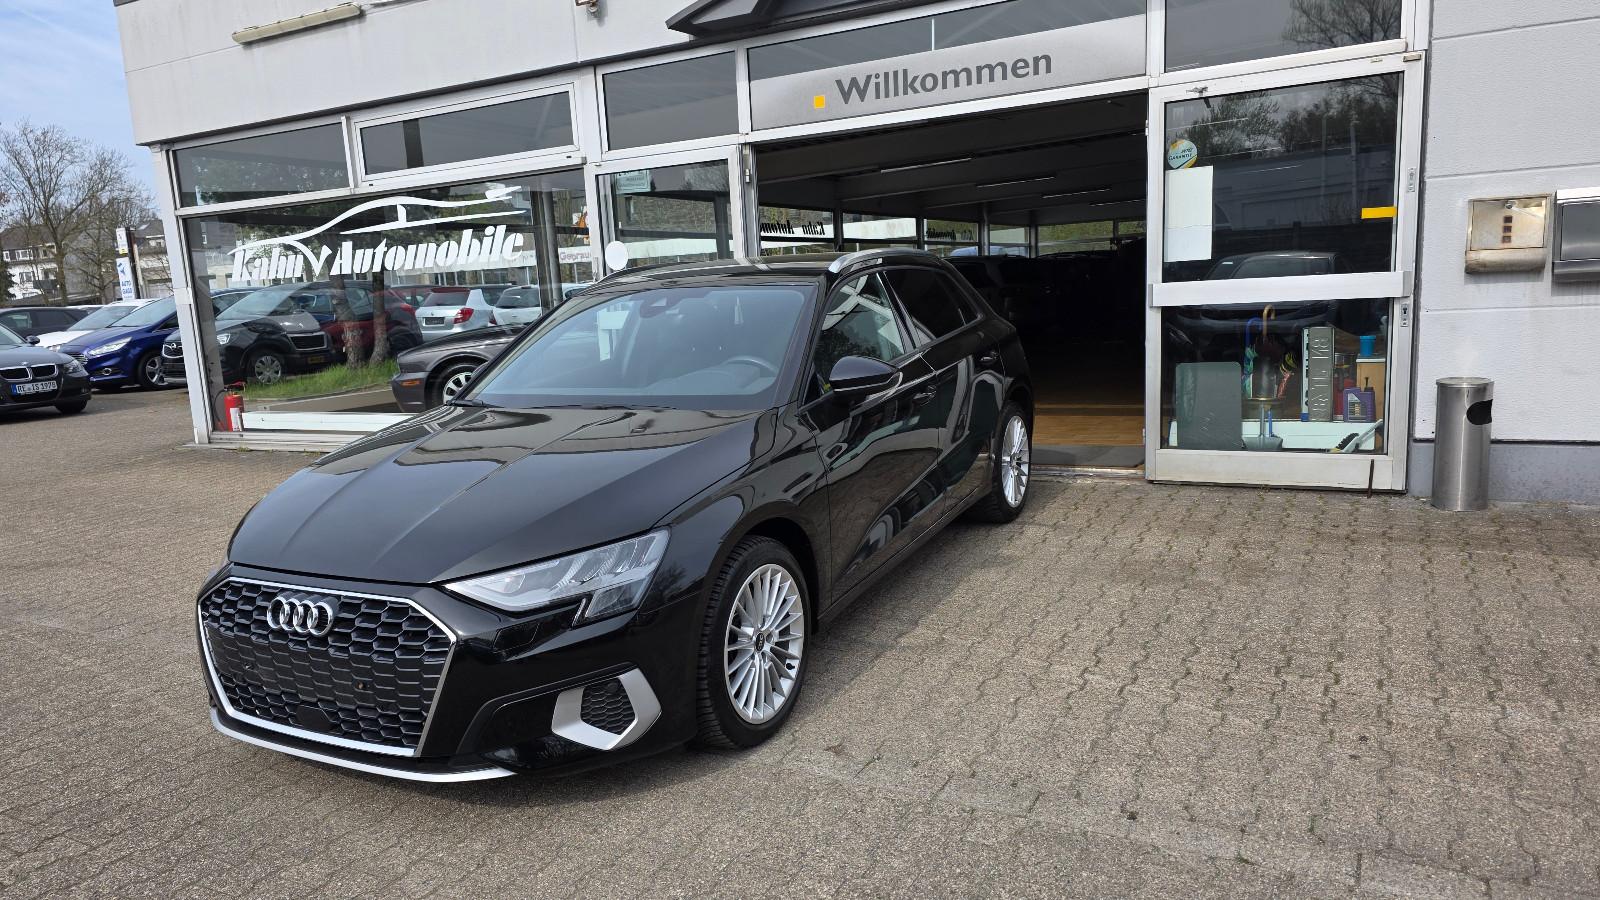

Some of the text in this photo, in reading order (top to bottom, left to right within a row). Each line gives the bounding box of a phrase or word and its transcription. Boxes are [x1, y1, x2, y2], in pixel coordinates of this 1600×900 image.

[835, 53, 1053, 105] Willkommen
[231, 224, 524, 282] Kahn Automobile
